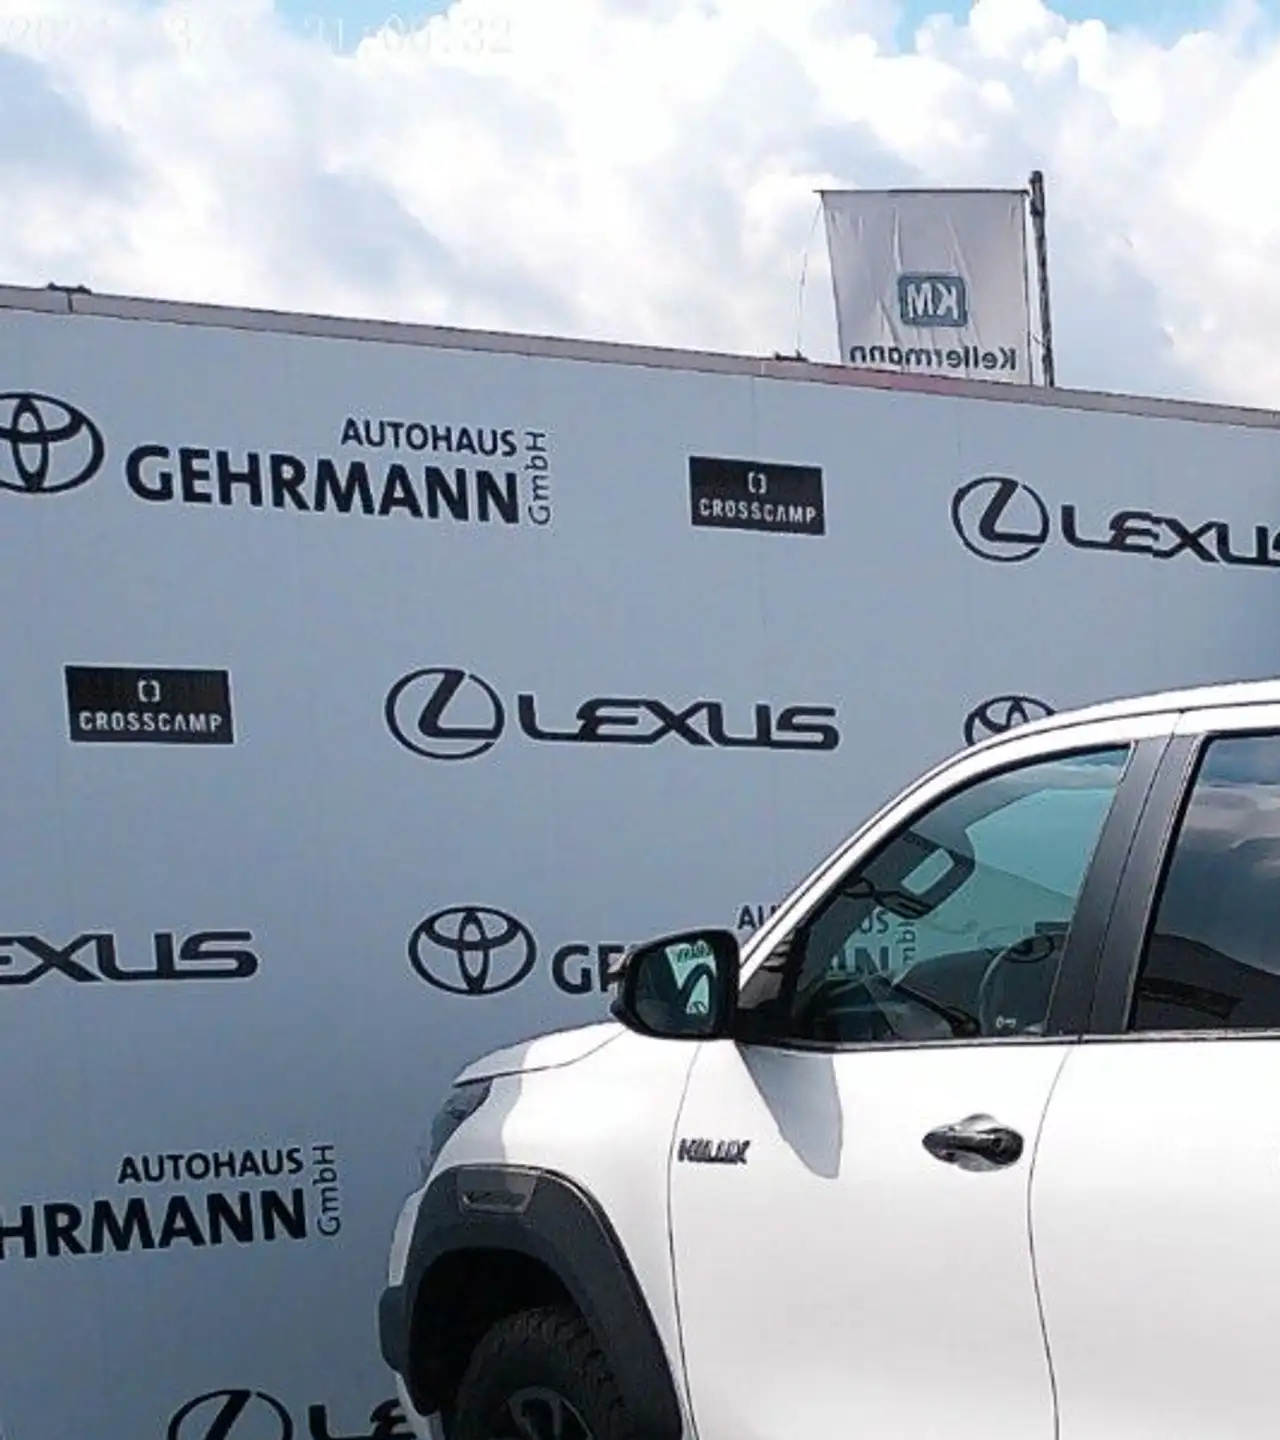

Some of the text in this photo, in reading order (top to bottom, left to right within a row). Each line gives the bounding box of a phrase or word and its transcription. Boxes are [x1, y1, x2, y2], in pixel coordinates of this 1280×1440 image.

[340, 417, 517, 457] AUTOHAUS
[125, 446, 519, 524] GEHRMANN
[525, 431, 551, 526] GmbH
[698, 497, 817, 526] CROSSCAMP
[79, 711, 223, 733] CROSSCAMP
[517, 694, 840, 751] LEXUS
[0, 931, 259, 985] XUS
[117, 1147, 304, 1185] AUTOHAUS
[311, 1144, 342, 1237] GmbH
